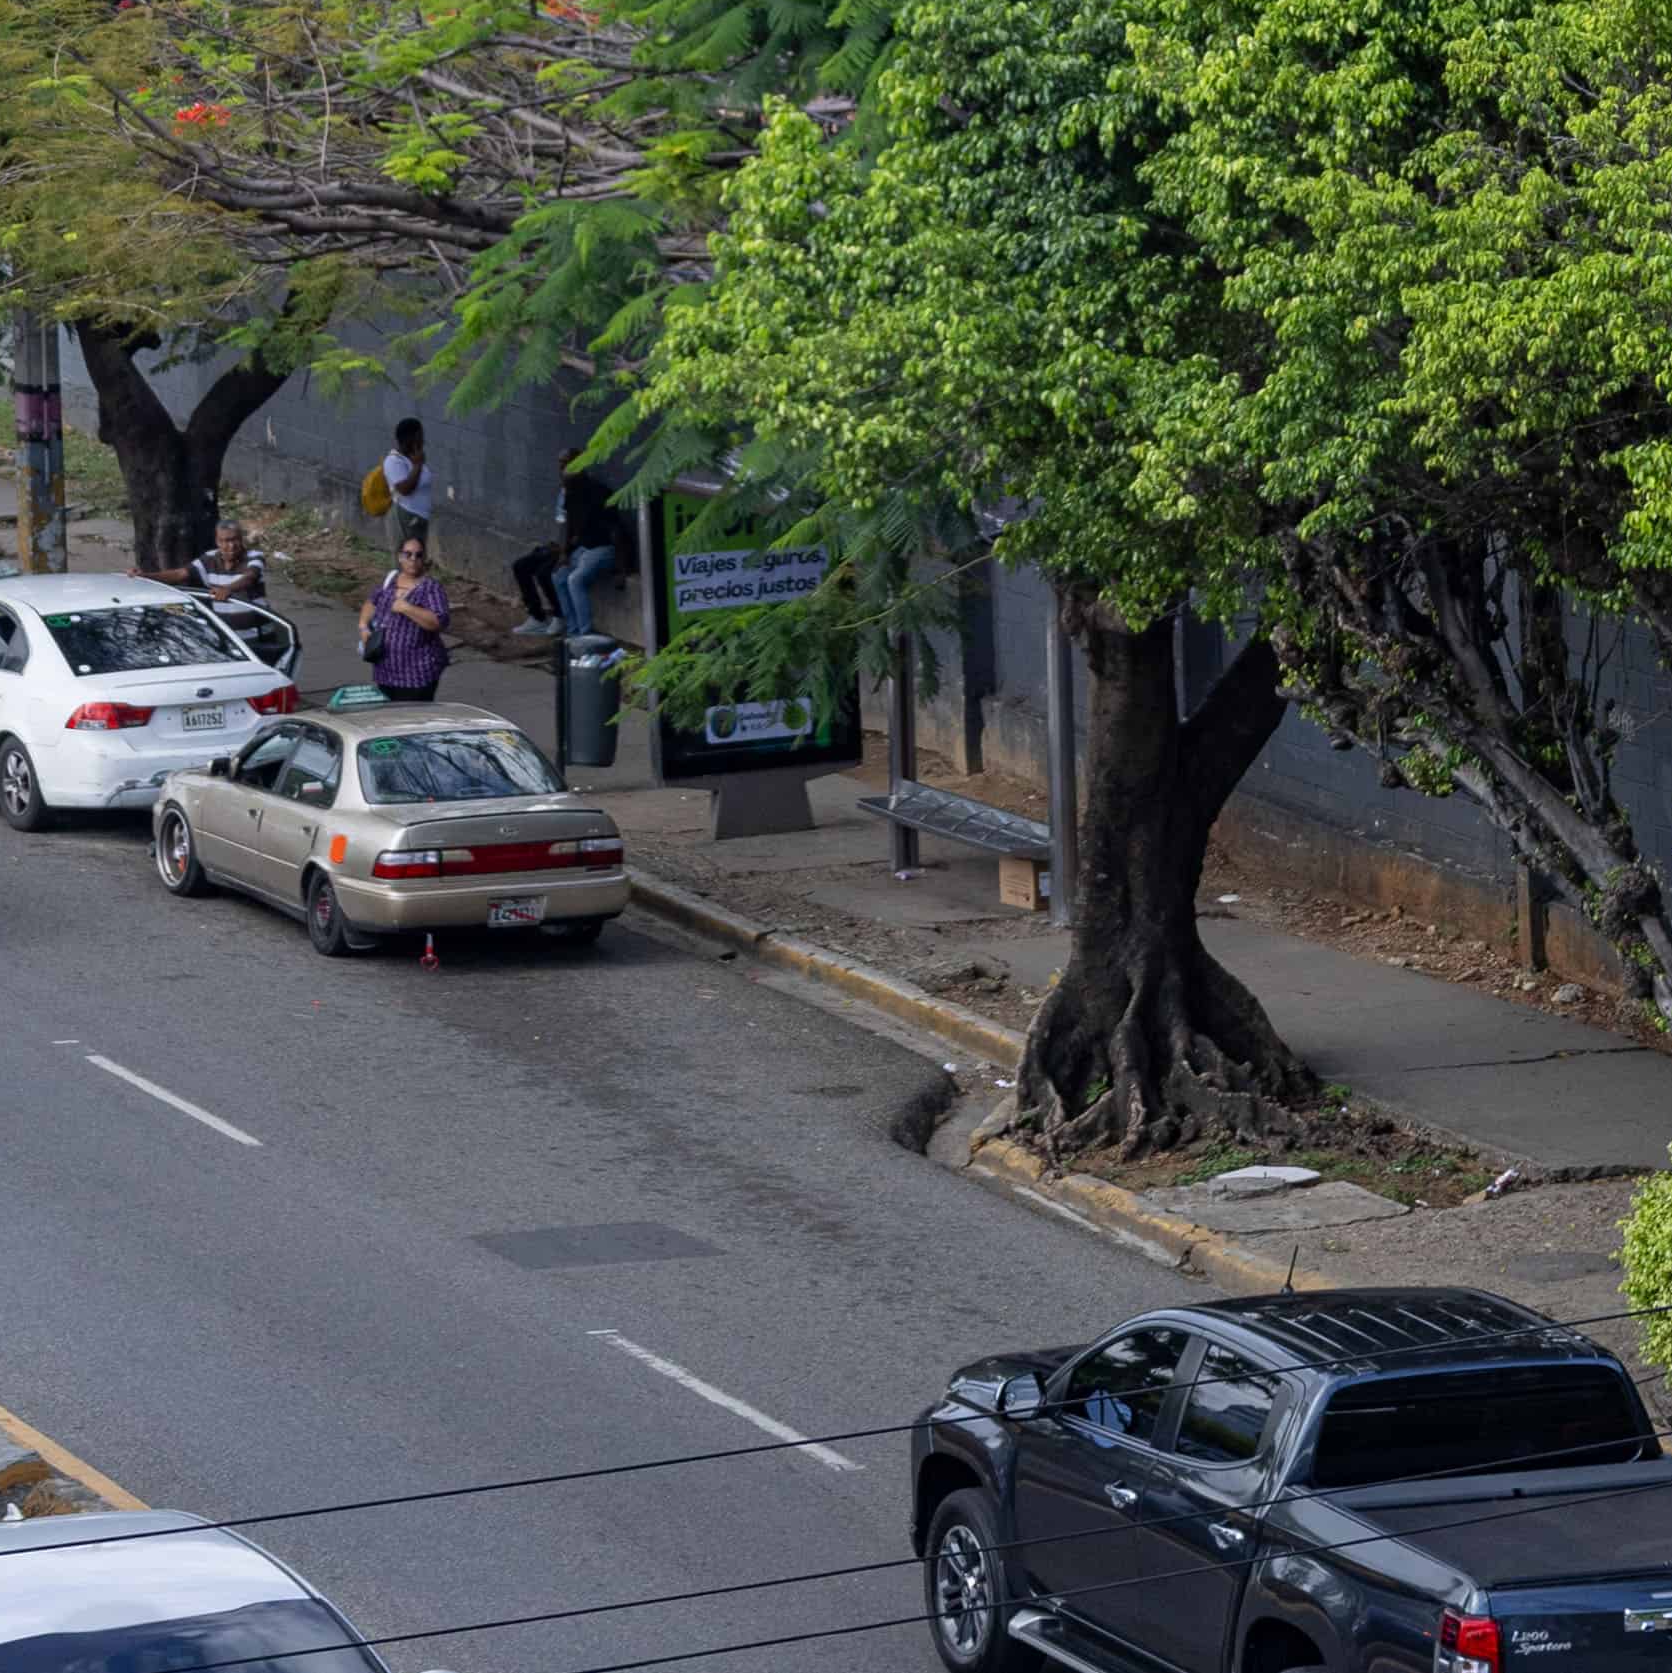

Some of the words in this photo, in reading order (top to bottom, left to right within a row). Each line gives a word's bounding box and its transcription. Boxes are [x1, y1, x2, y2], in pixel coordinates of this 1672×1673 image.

[677, 555, 737, 578] Viajes
[678, 580, 753, 607] precios
[757, 576, 817, 601] justos
